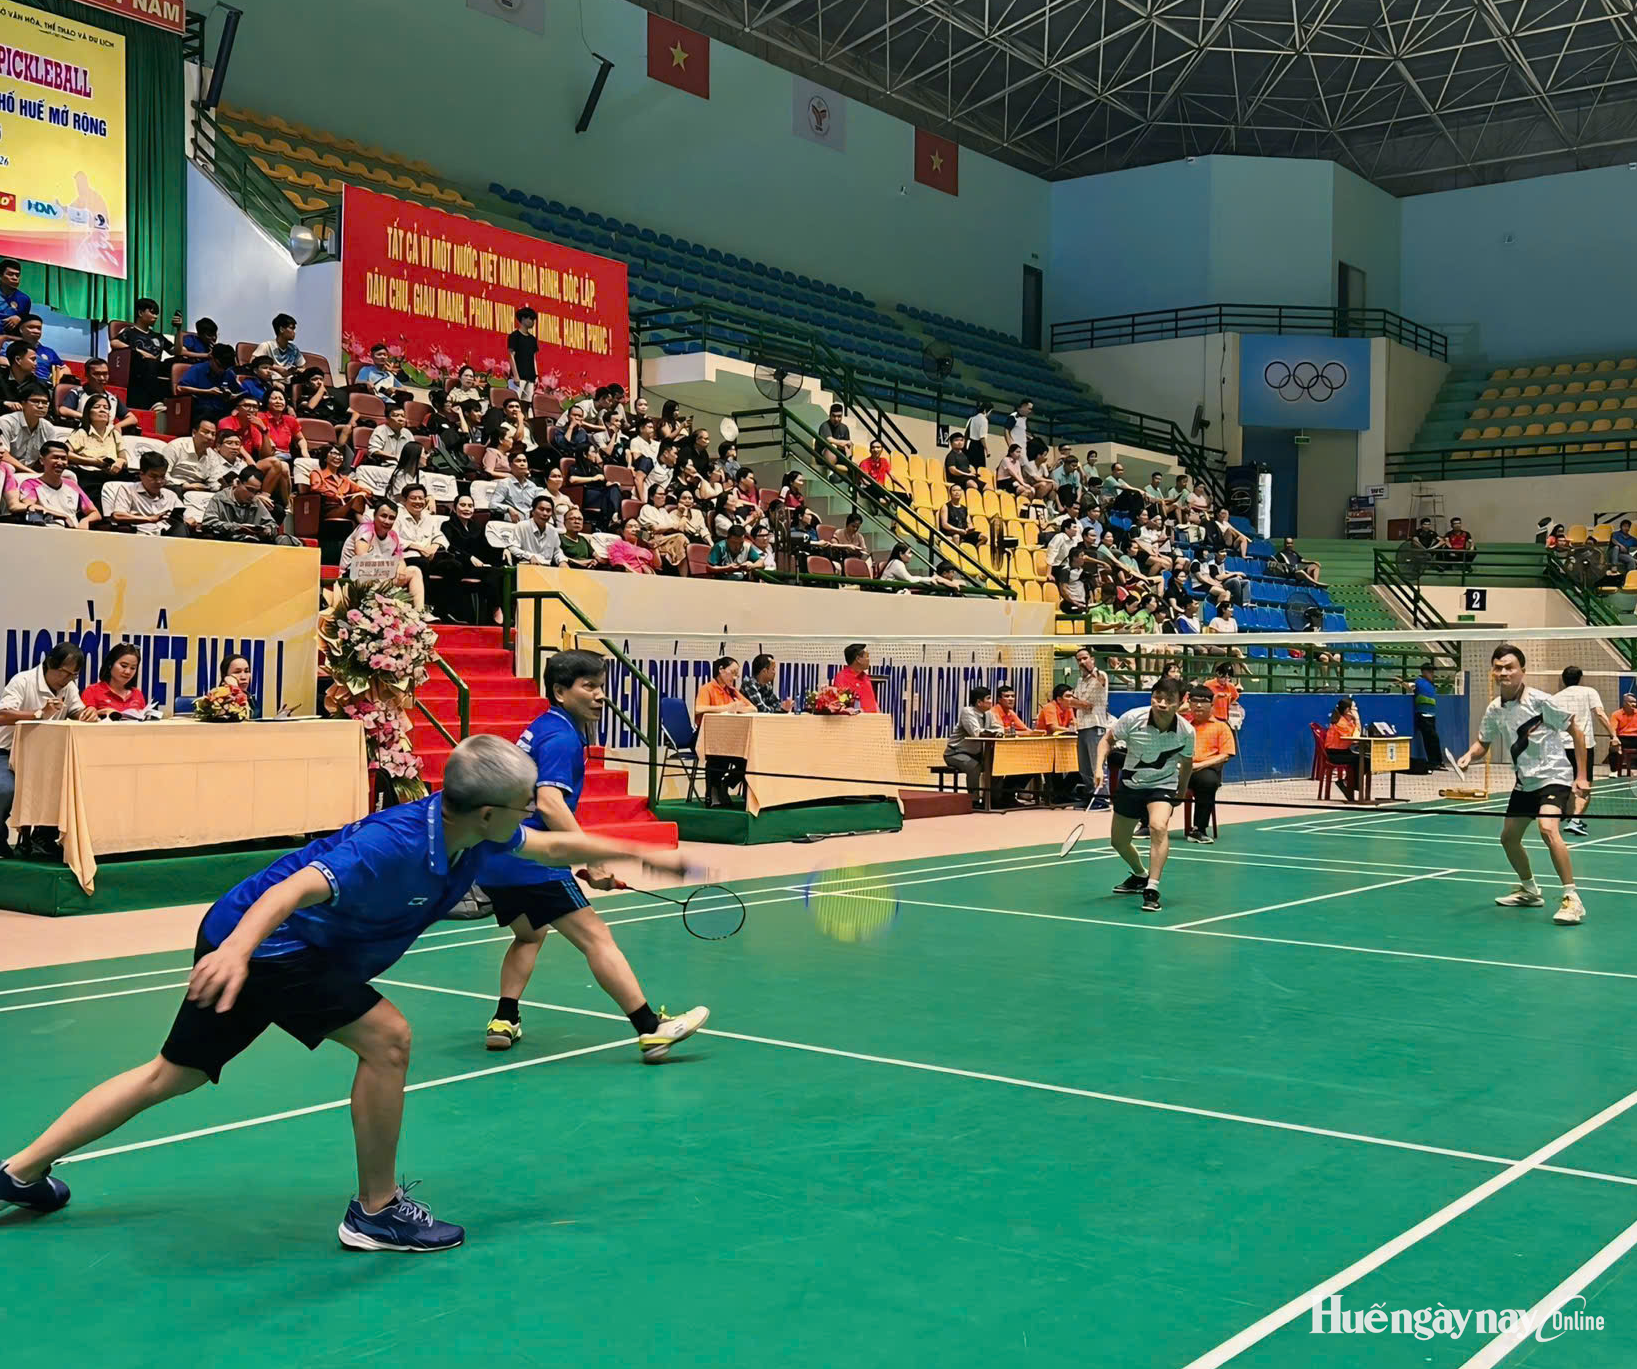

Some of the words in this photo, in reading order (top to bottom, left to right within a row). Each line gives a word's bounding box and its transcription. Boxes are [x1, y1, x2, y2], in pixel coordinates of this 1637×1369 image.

[0, 45, 92, 98] PICKLEBALL
[20, 99, 45, 121] HUẾ
[48, 104, 69, 127] MỞ
[73, 112, 107, 137] RỘNG
[387, 217, 404, 262] TẤT
[406, 222, 419, 266] CẢ
[421, 229, 430, 268] VÌ
[432, 234, 452, 280] MỘT
[454, 241, 478, 280] NƯỚC
[480, 246, 498, 290] VIỆT
[499, 256, 520, 290] NAM
[366, 266, 387, 308] DÂN
[413, 278, 436, 318] GIÀU
[563, 317, 586, 355] HẠNH
[586, 319, 608, 356] PHÚC
[1471, 591, 1480, 608] 2
